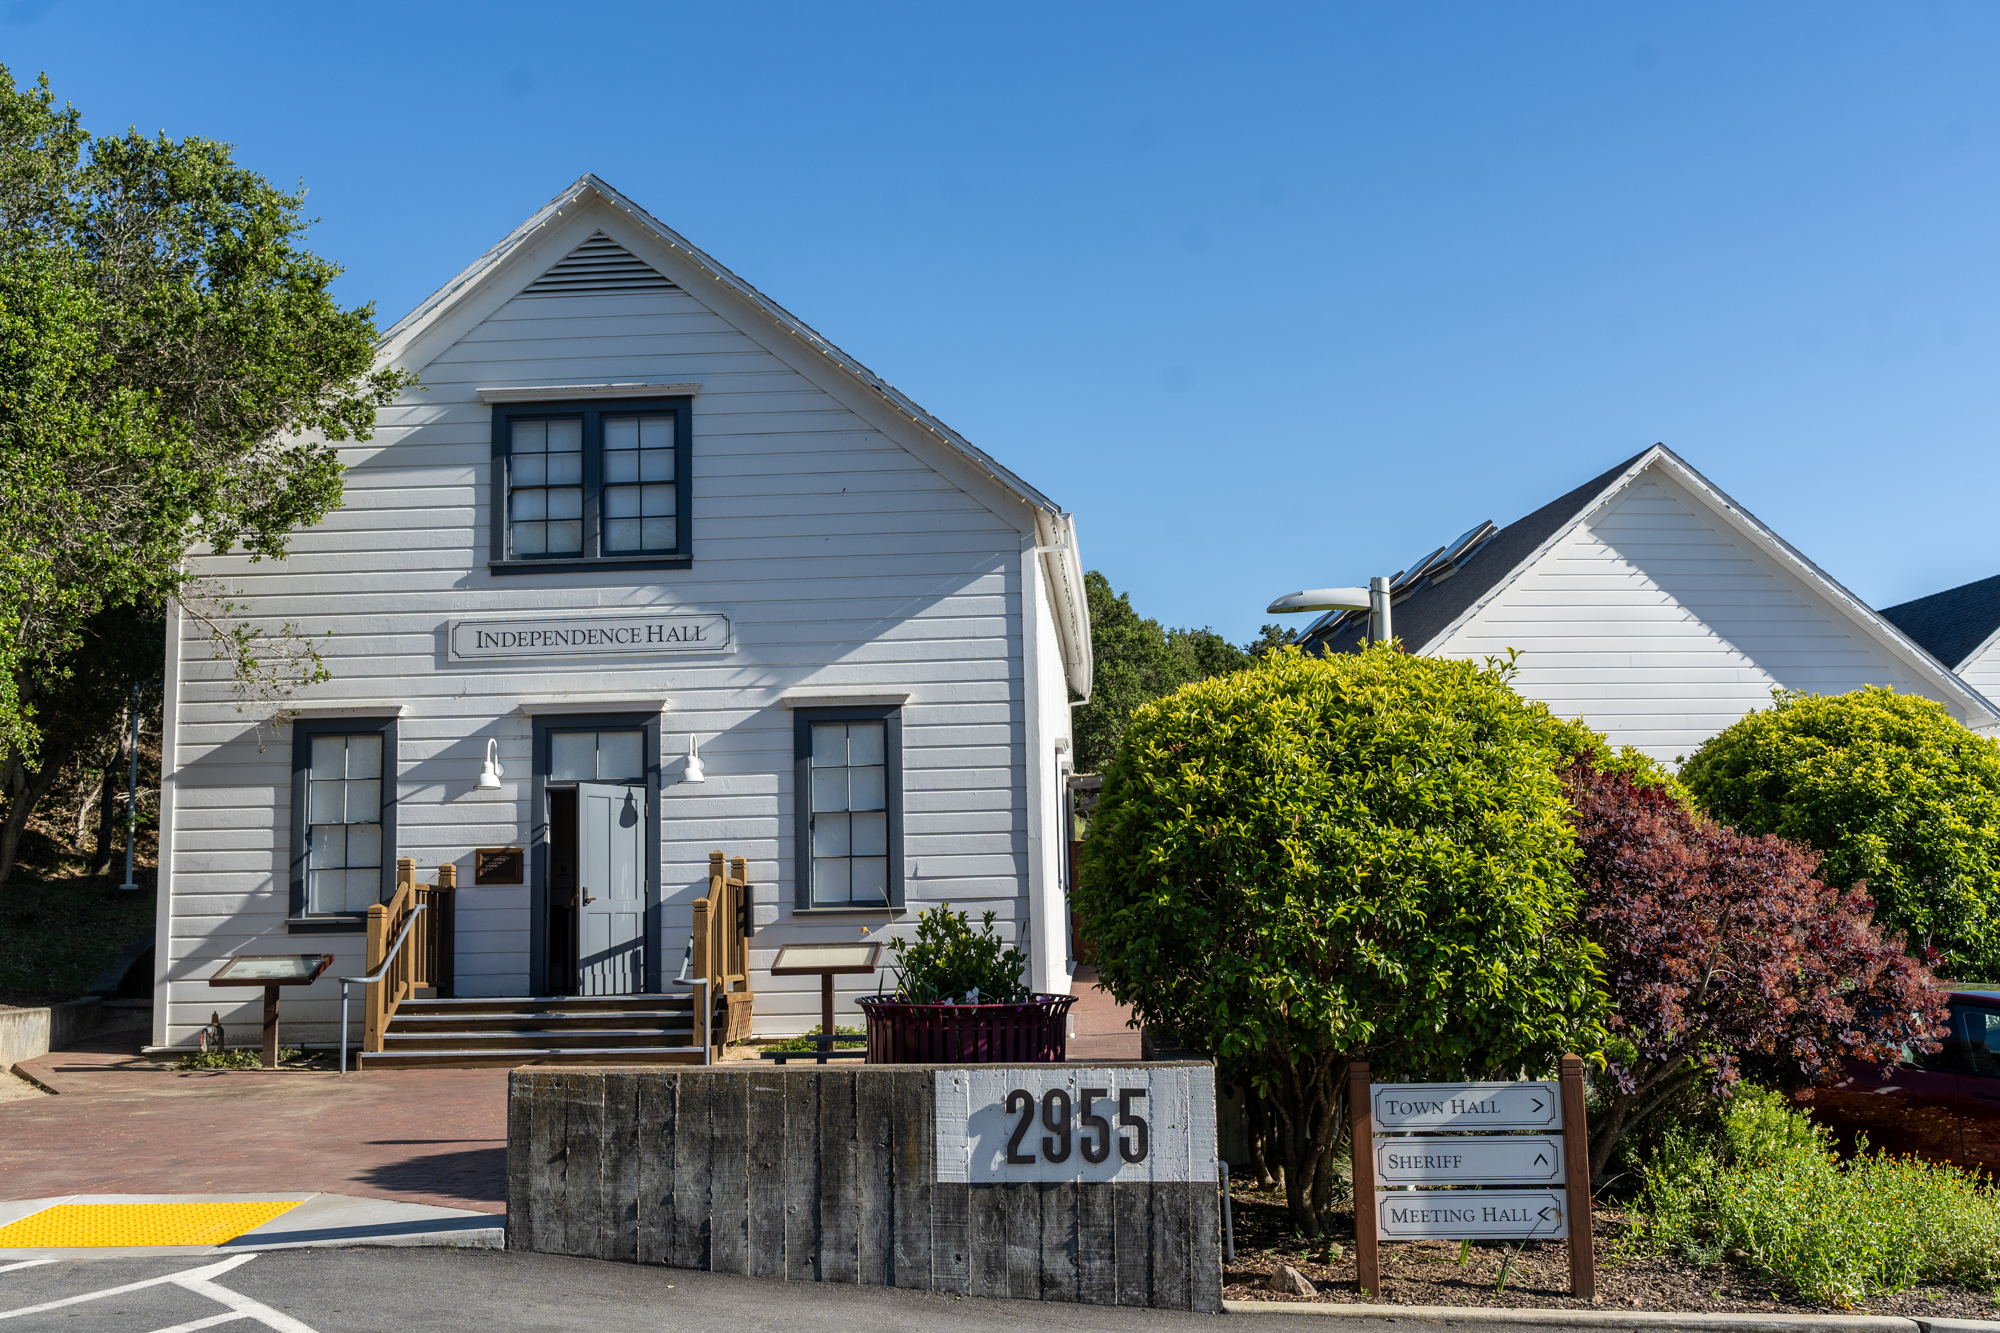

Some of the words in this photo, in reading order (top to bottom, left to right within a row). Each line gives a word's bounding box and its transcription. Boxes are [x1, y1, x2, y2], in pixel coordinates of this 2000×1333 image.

[475, 627, 642, 649] INDEPENDENCE
[645, 624, 707, 643] HALL
[1385, 1100, 1444, 1116] TOWN
[1450, 1099, 1501, 1114] HALL
[1005, 1088, 1149, 1165] 2955
[1388, 1153, 1462, 1170] SHERIFF
[1390, 1208, 1475, 1224] MEETING
[1481, 1206, 1533, 1222] HALL
